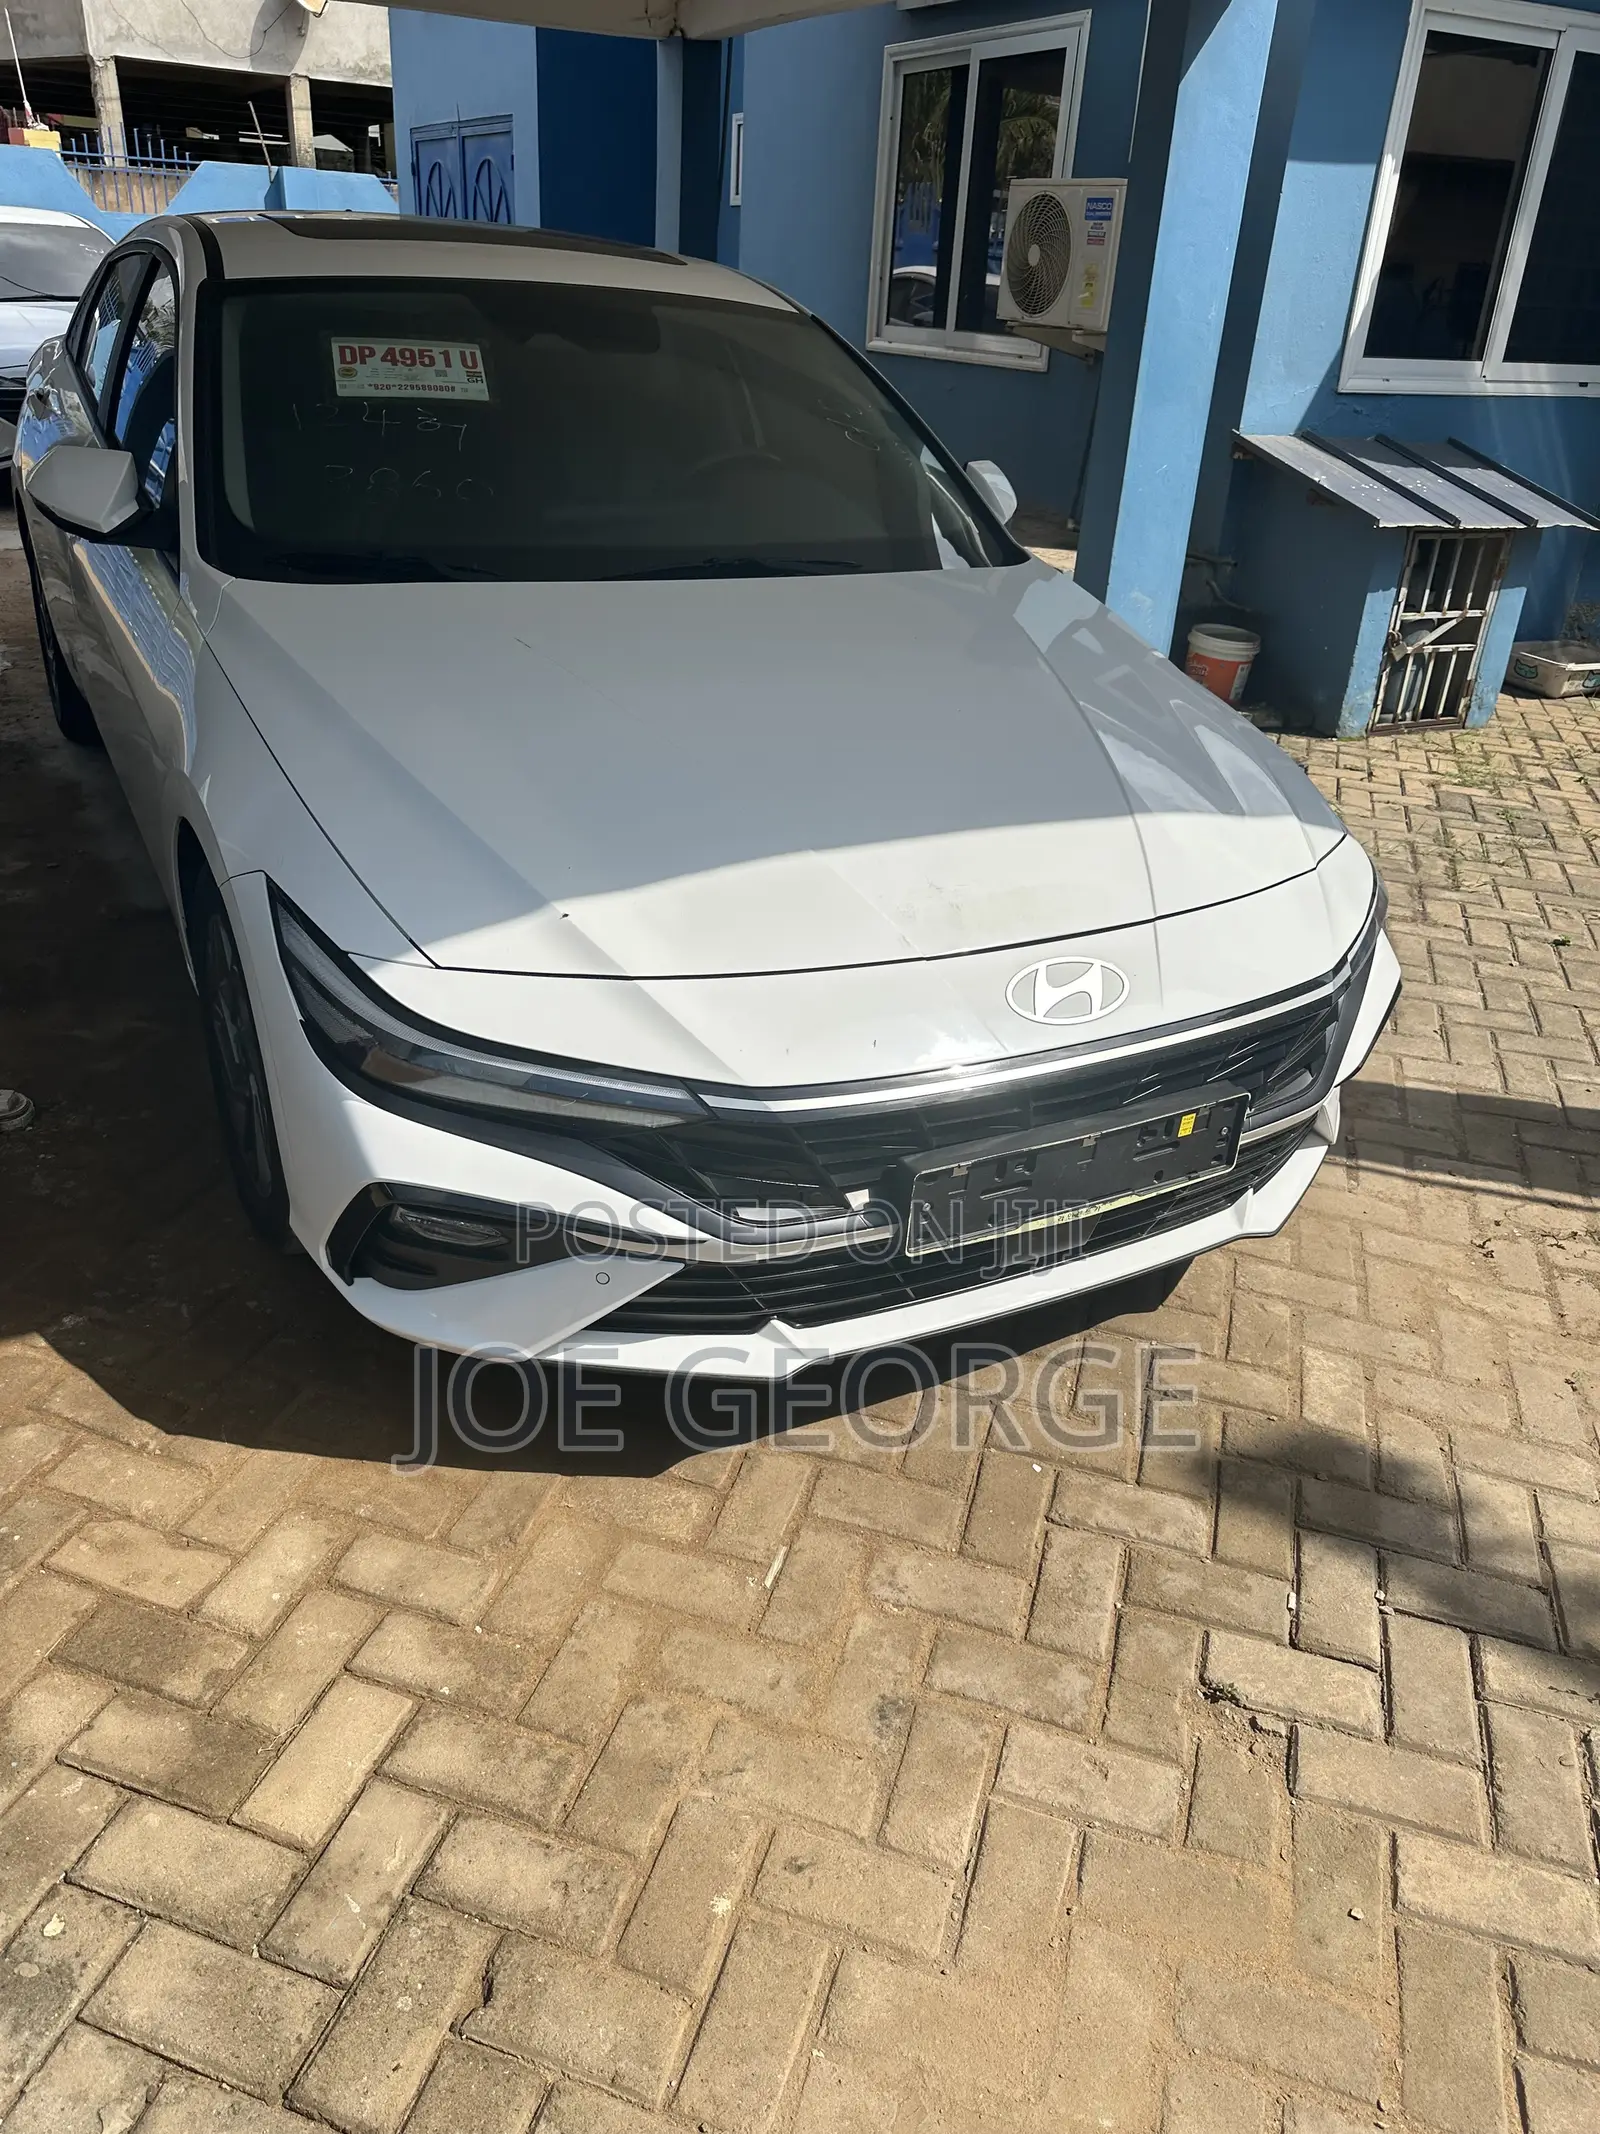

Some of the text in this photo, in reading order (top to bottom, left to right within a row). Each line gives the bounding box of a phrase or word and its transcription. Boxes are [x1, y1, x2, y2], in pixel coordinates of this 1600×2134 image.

[1087, 202, 1112, 210] NASCO
[338, 345, 479, 370] DP 4951 U
